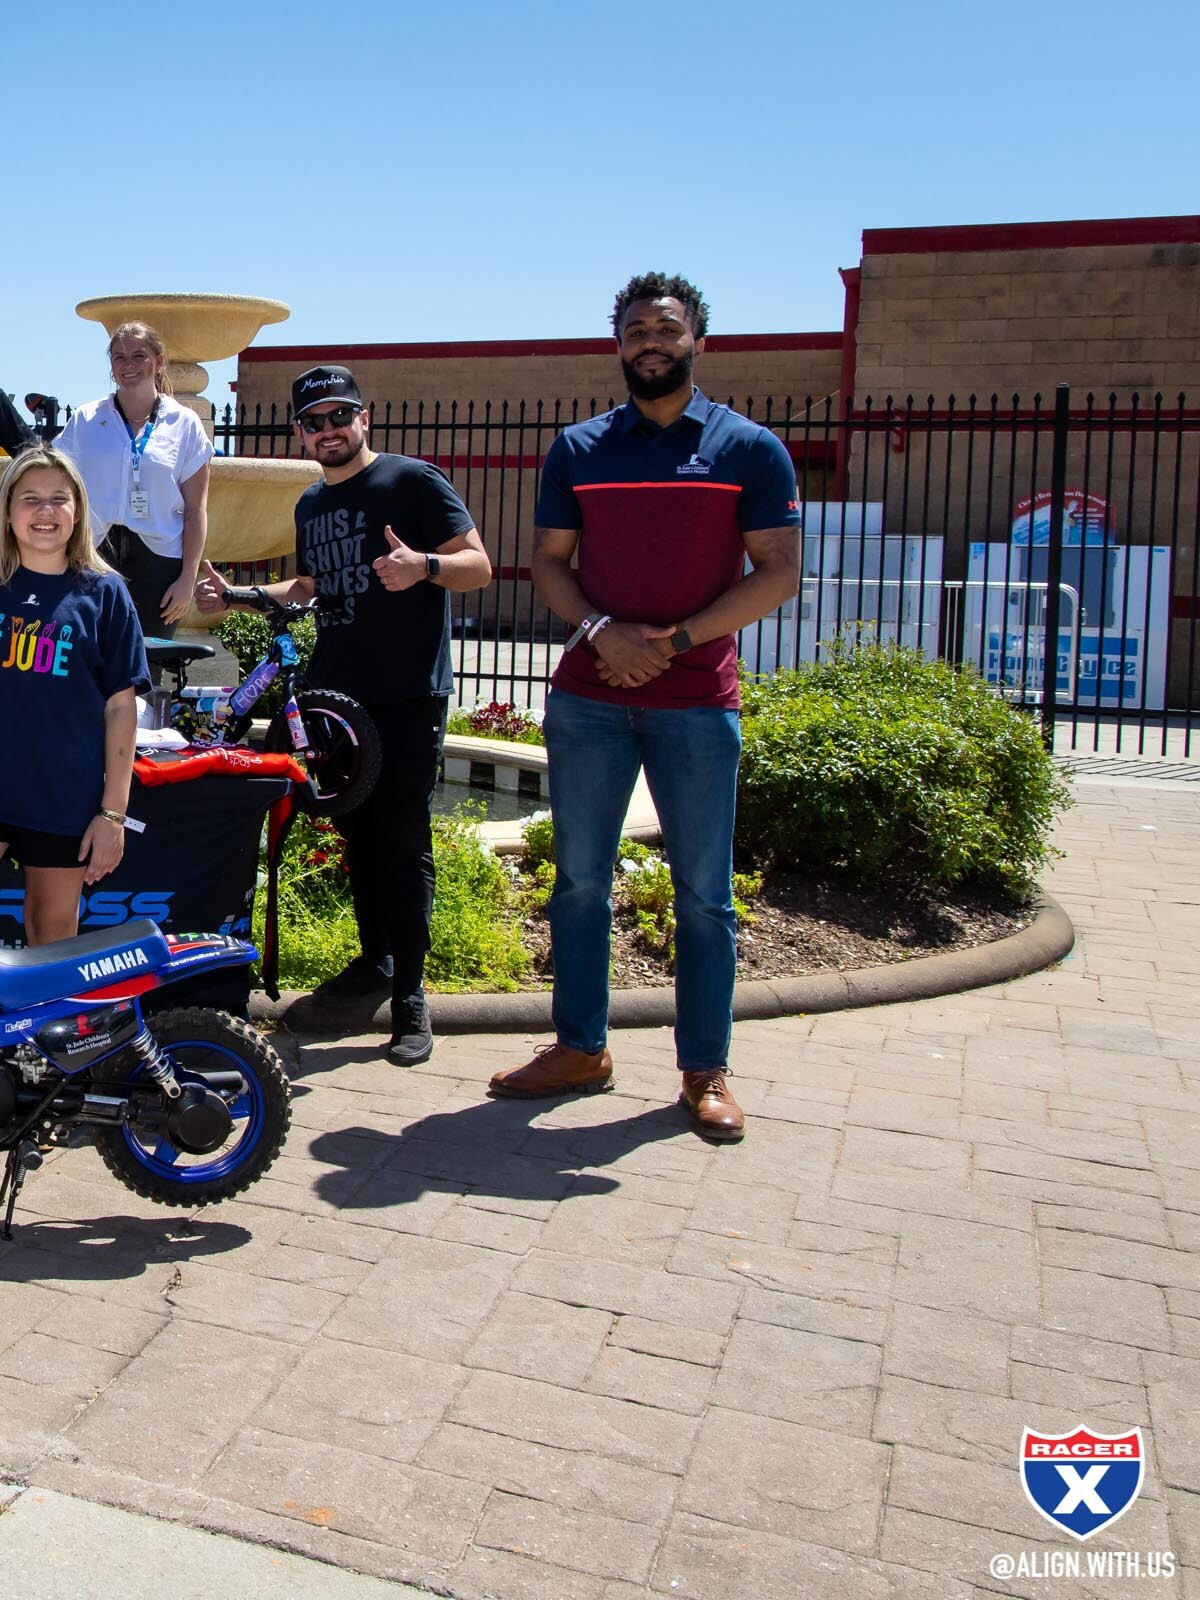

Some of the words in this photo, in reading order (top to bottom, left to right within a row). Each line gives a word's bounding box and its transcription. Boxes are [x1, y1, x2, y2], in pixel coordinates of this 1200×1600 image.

[301, 374, 345, 393] Memphis
[303, 508, 350, 548] THIS
[305, 533, 367, 577] SHIRT
[2, 632, 73, 677] JUDE
[229, 756, 251, 768] spas
[78, 948, 149, 982] YAMAHA
[68, 1045, 90, 1055] Research
[90, 1038, 112, 1050] Hospital
[73, 1039, 85, 1048] Jude
